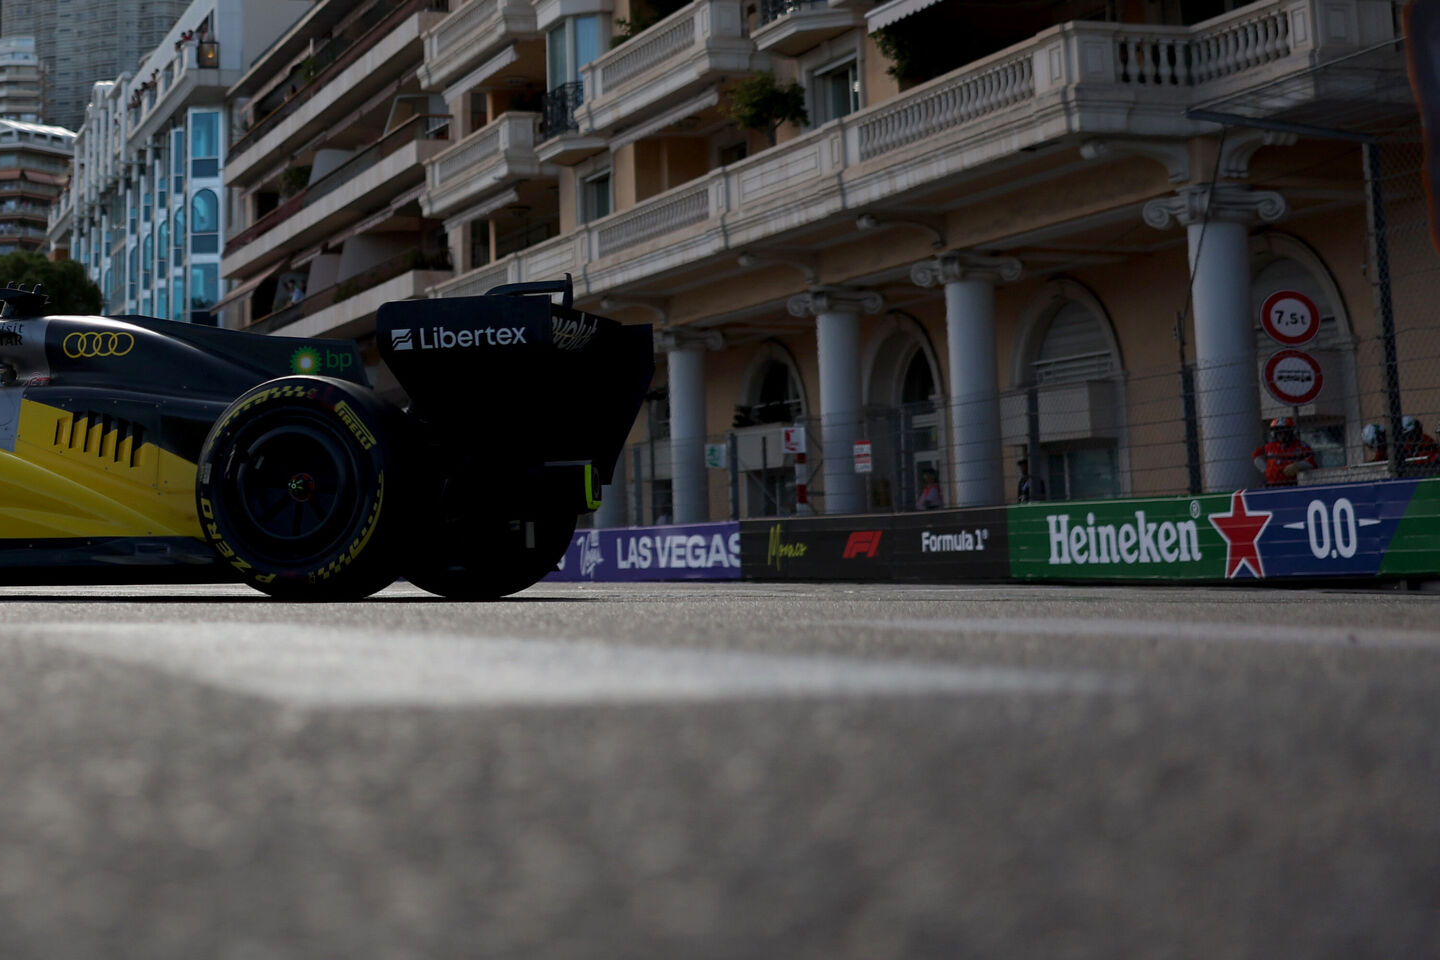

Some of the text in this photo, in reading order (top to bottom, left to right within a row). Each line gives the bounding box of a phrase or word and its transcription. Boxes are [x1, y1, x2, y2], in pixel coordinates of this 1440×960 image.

[420, 325, 527, 350] Libertex
[326, 348, 353, 372] bp
[334, 399, 377, 452] PIRELLI
[920, 528, 973, 553] Formula
[1306, 498, 1358, 560] 0.0
[615, 535, 653, 570] LAS
[654, 532, 742, 569] VEGAS
